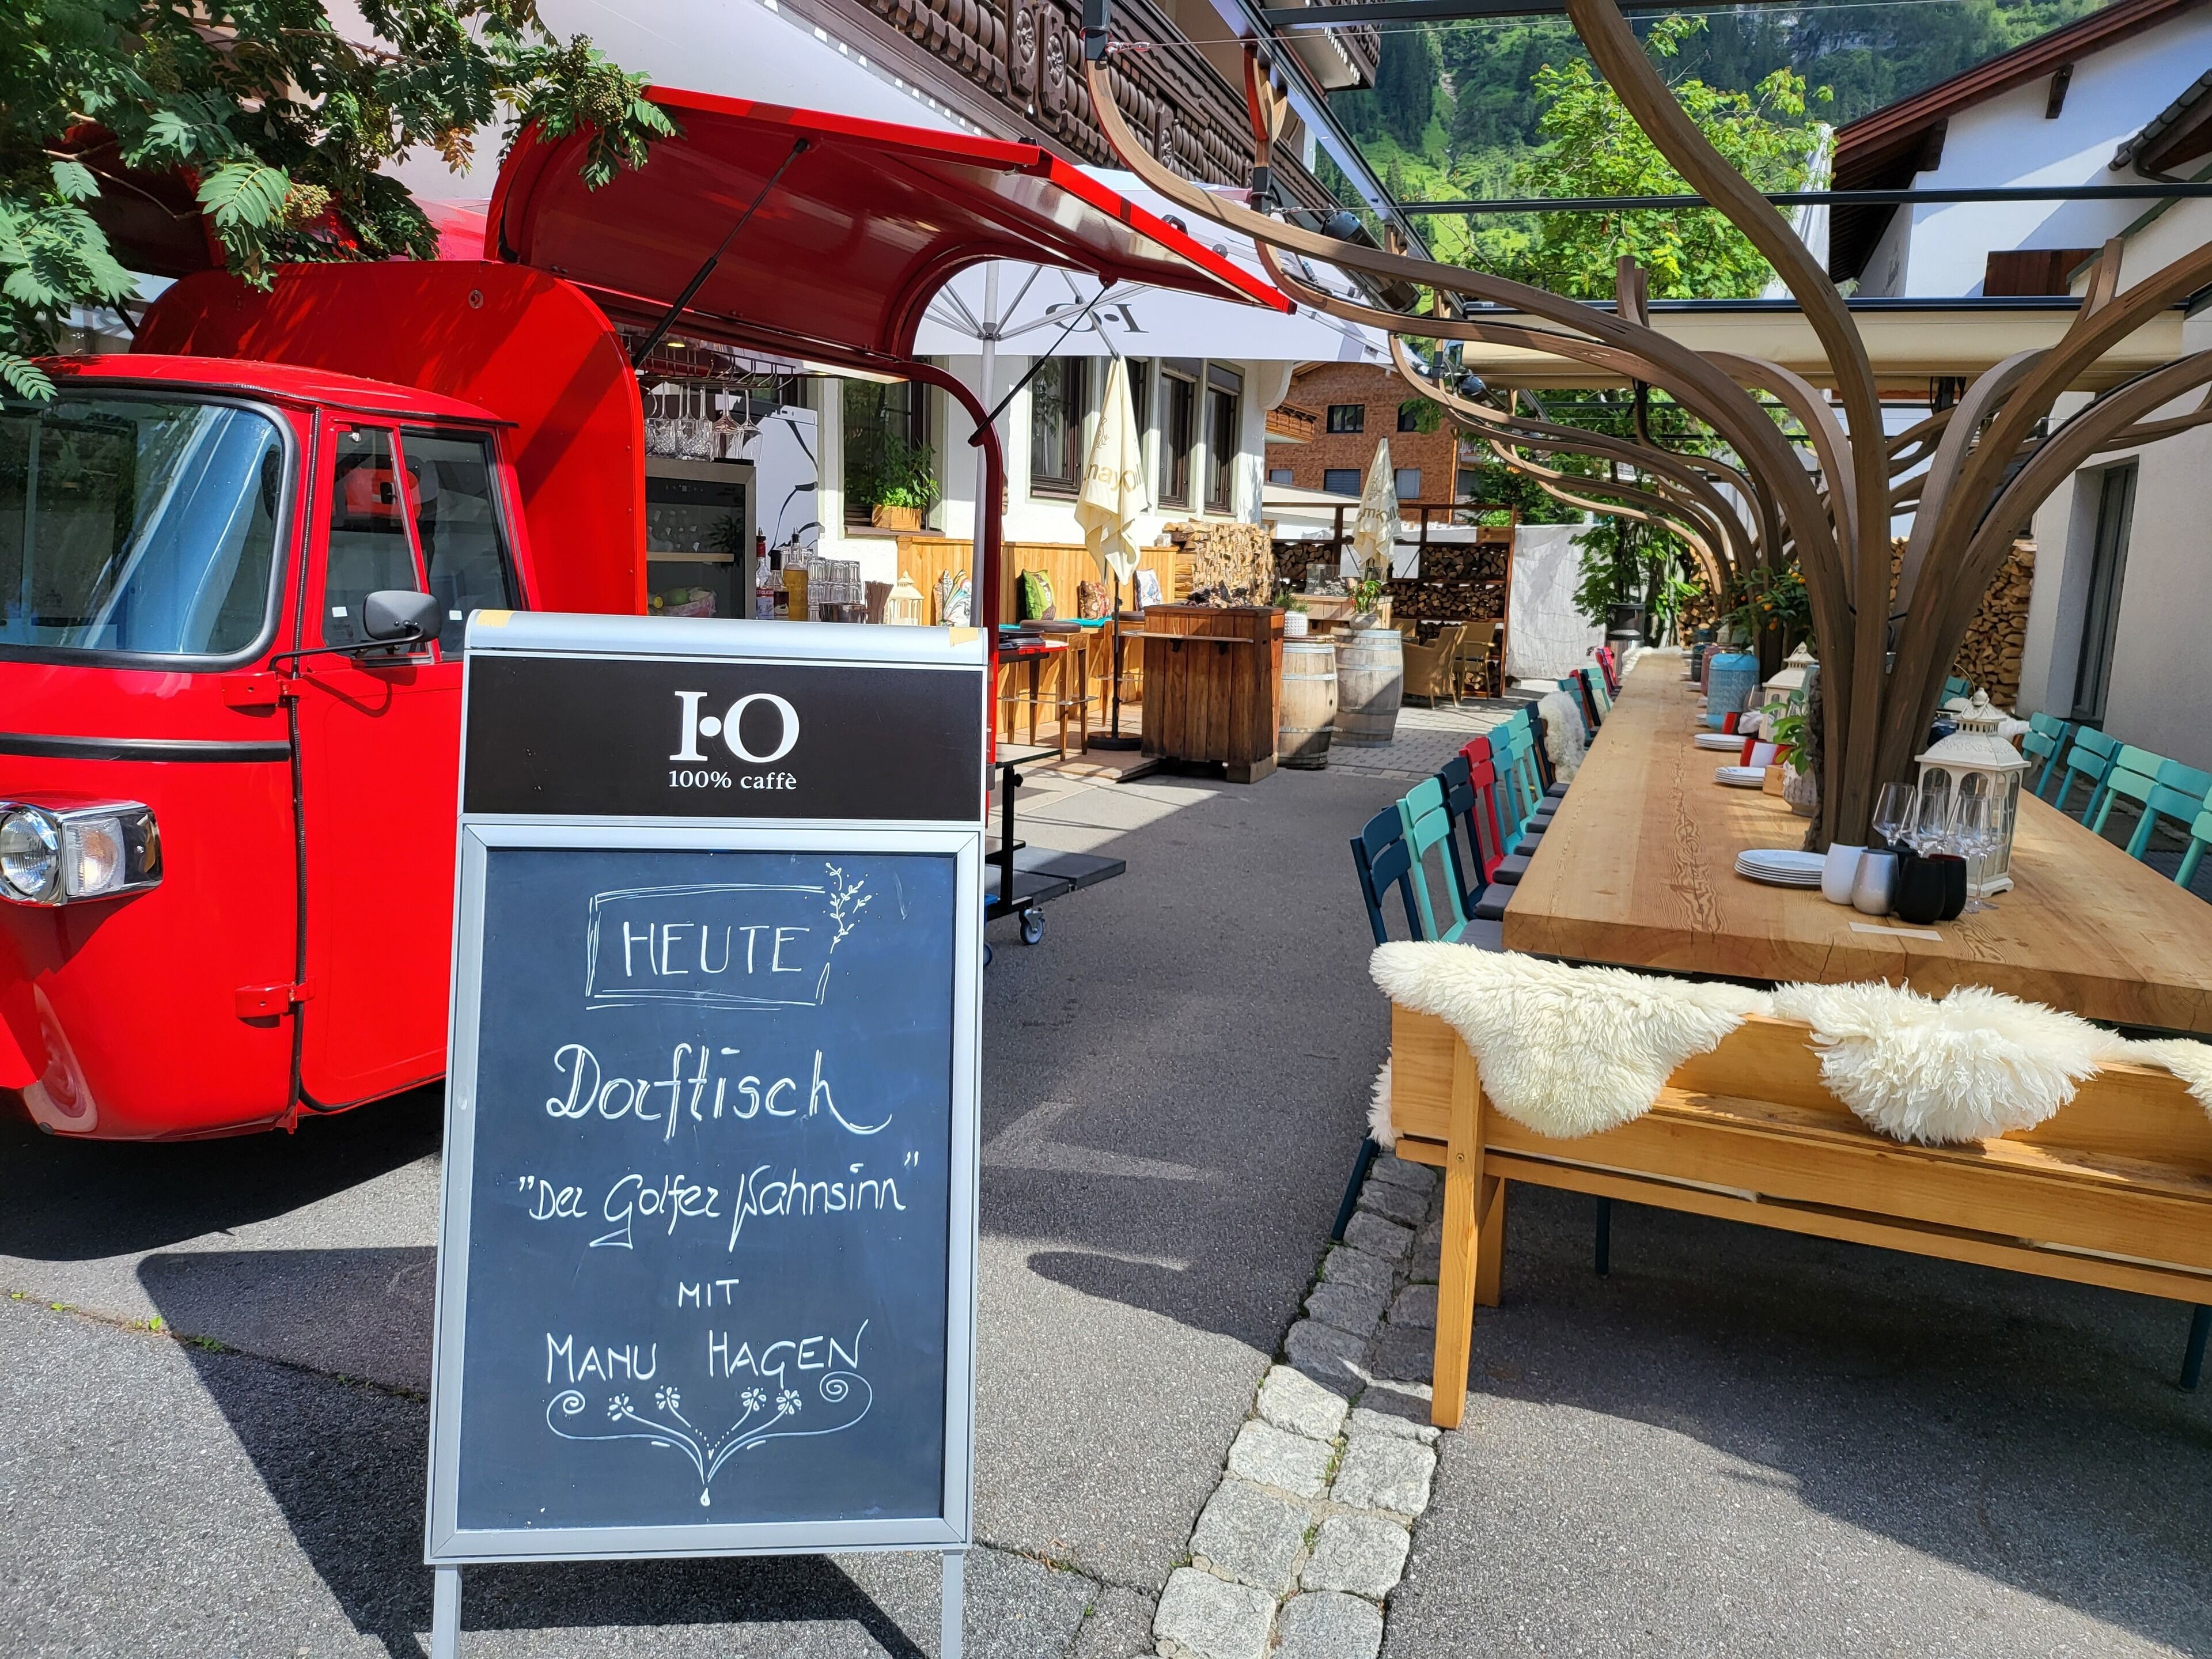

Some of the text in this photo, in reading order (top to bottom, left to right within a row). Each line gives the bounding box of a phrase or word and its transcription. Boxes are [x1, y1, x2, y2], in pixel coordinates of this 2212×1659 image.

[669, 770, 797, 790] 100% caffè
[623, 921, 810, 977] HEUTE
[546, 1043, 892, 1141] Dorftisch
[589, 1173, 721, 1249] Golfer
[678, 1279, 740, 1308] MIT
[546, 1319, 869, 1389] MANU HAGEN
